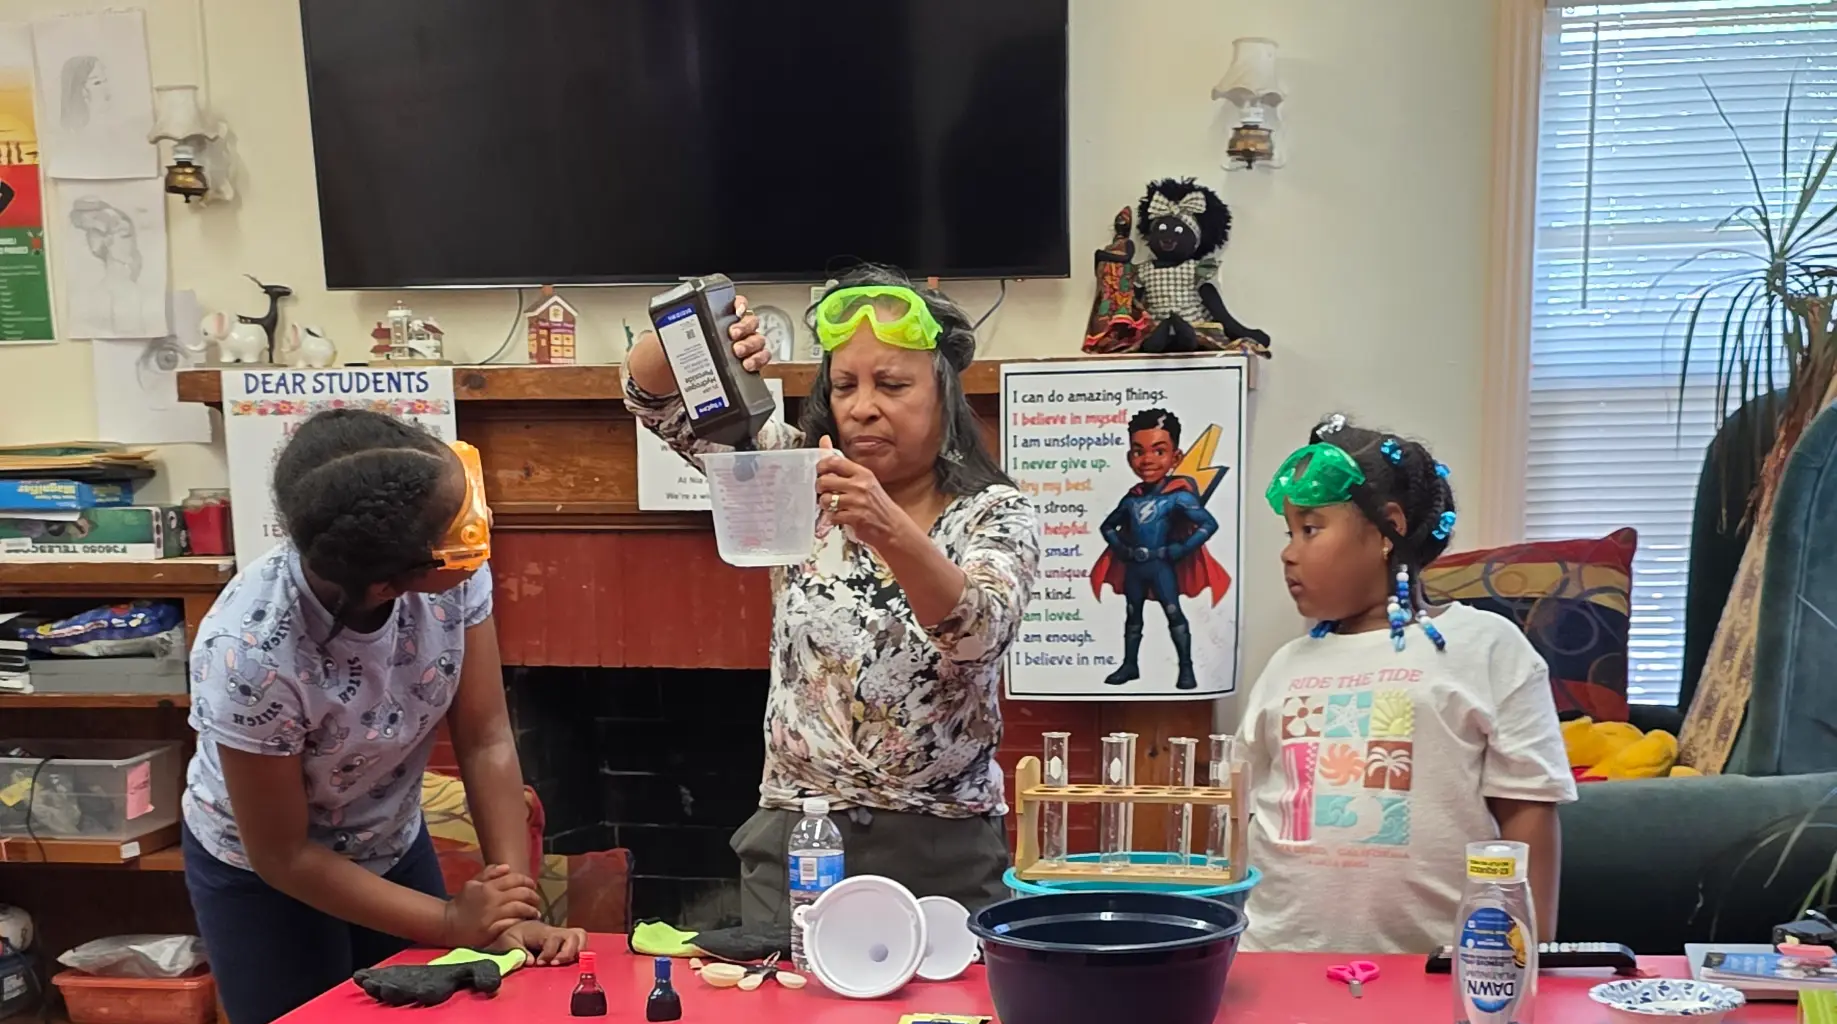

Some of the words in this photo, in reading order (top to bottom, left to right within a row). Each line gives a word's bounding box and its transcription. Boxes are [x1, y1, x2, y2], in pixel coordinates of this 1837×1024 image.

[243, 372, 306, 395] DEAR
[312, 371, 429, 394] STUDENTS
[1013, 390, 1018, 403] I
[1021, 393, 1045, 403] can
[1047, 389, 1064, 403] do
[1067, 389, 1122, 406] amazing
[1125, 386, 1168, 405] things.
[1013, 413, 1018, 426] I
[1021, 411, 1067, 426] believe
[1070, 412, 1082, 425] in
[1013, 435, 1018, 448] I
[1021, 436, 1041, 448] am
[1044, 433, 1125, 450] unstoppable.
[1013, 457, 1018, 470] I
[1021, 459, 1057, 470] never
[1060, 458, 1087, 474] give
[1090, 458, 1111, 472] up.
[1042, 482, 1062, 496] my
[1044, 500, 1088, 518] strong.
[1045, 544, 1083, 558] smart.
[1045, 587, 1076, 600] kind.
[1023, 612, 1041, 622] am
[1044, 608, 1084, 622] loved.
[1023, 633, 1042, 643] am
[1045, 629, 1096, 647] enough.
[1016, 651, 1020, 665] I
[1025, 651, 1073, 666] believe
[1076, 652, 1089, 666] in
[1093, 655, 1117, 665] me.
[1288, 676, 1334, 691] RIDE
[1337, 672, 1375, 688] THE
[1378, 668, 1424, 682] TIDE
[233, 701, 284, 727] STITCH
[1467, 980, 1514, 997] DAWN
